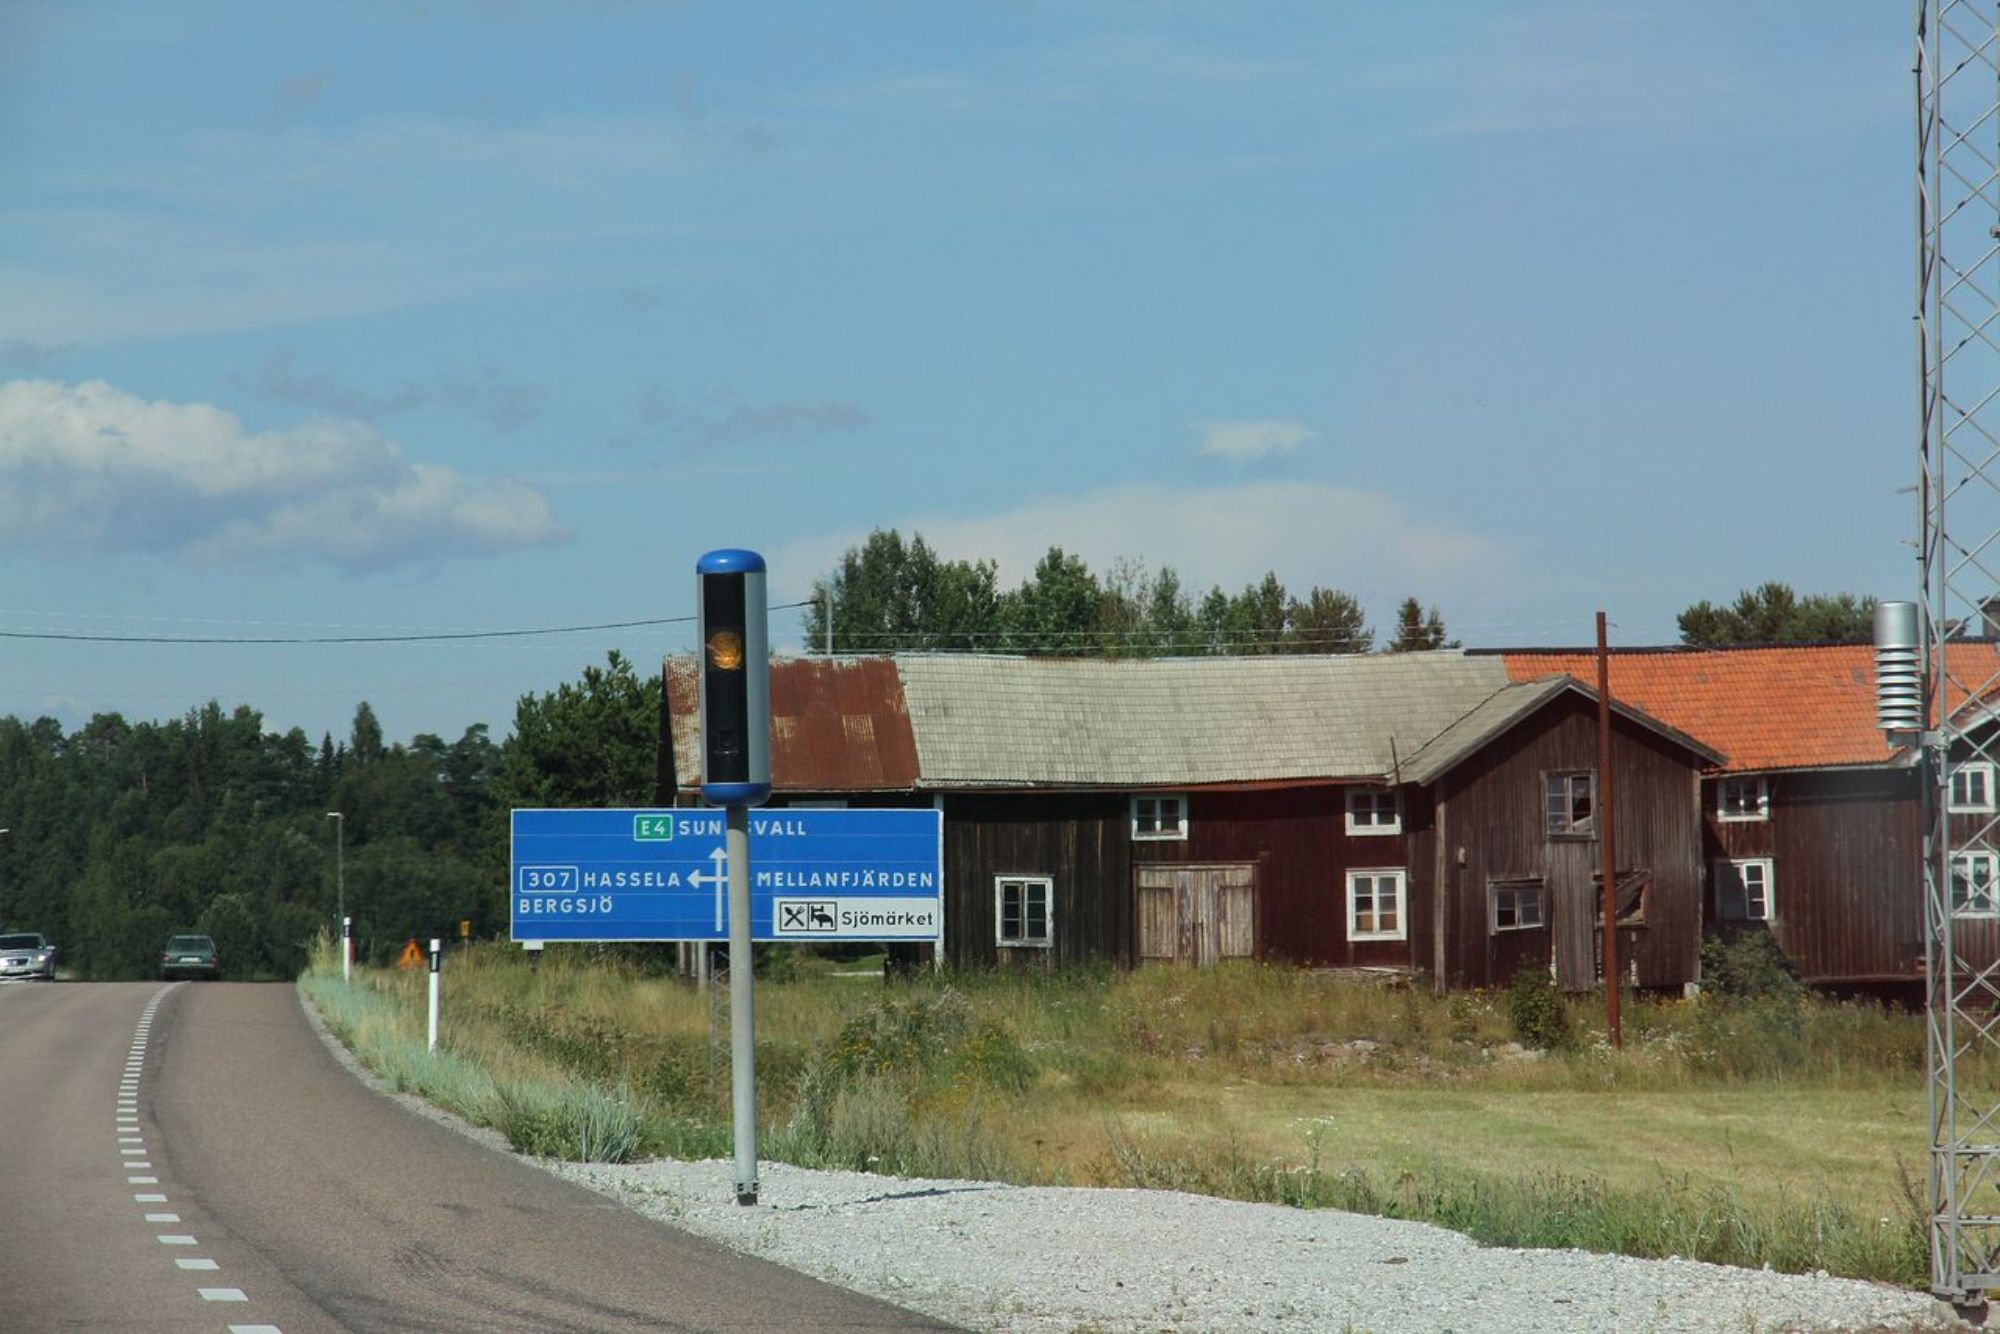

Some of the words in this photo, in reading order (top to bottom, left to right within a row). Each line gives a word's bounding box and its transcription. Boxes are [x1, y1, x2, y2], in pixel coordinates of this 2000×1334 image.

[641, 820, 666, 836] E4
[678, 820, 807, 836] SUNVALL
[528, 872, 570, 887] 307
[583, 872, 681, 887] HASSELA
[757, 869, 933, 887] MELLANFJÄRDEN
[519, 896, 613, 914] BERGSJÖ
[841, 911, 934, 929] Sjömärket
